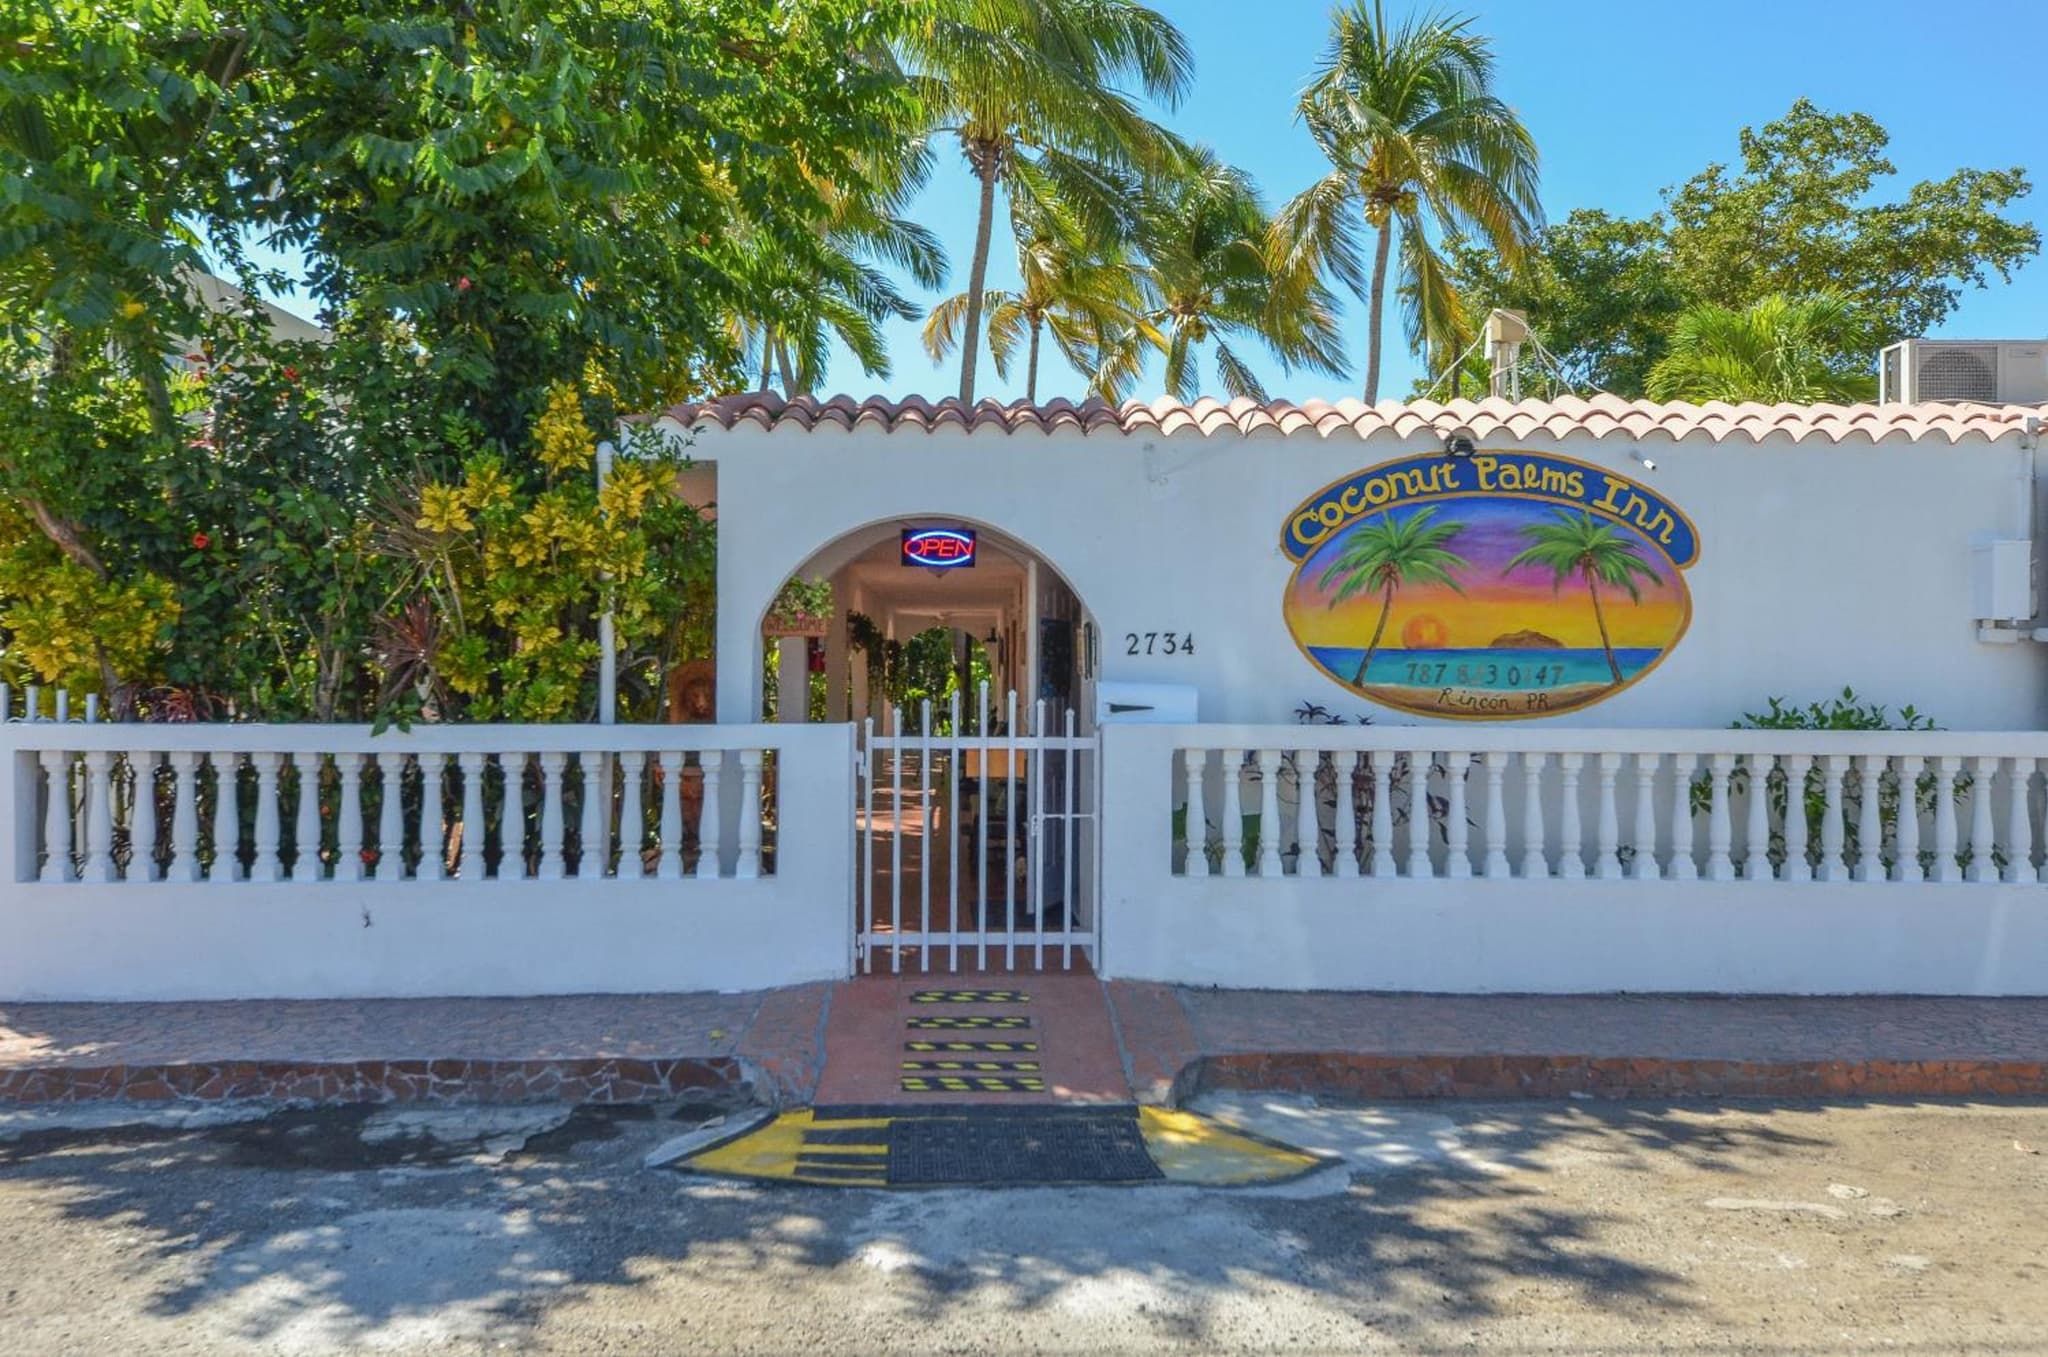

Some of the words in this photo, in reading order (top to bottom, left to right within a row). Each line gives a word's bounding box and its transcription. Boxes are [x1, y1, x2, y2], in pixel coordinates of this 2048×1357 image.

[1291, 462, 1460, 545] Coconut
[1469, 456, 1584, 498] Palms
[1592, 476, 1674, 544] Inn
[904, 538, 974, 557] OPEN
[1125, 631, 1195, 656] 2734
[1406, 662, 1448, 684] 787
[1526, 692, 1550, 710] PR
